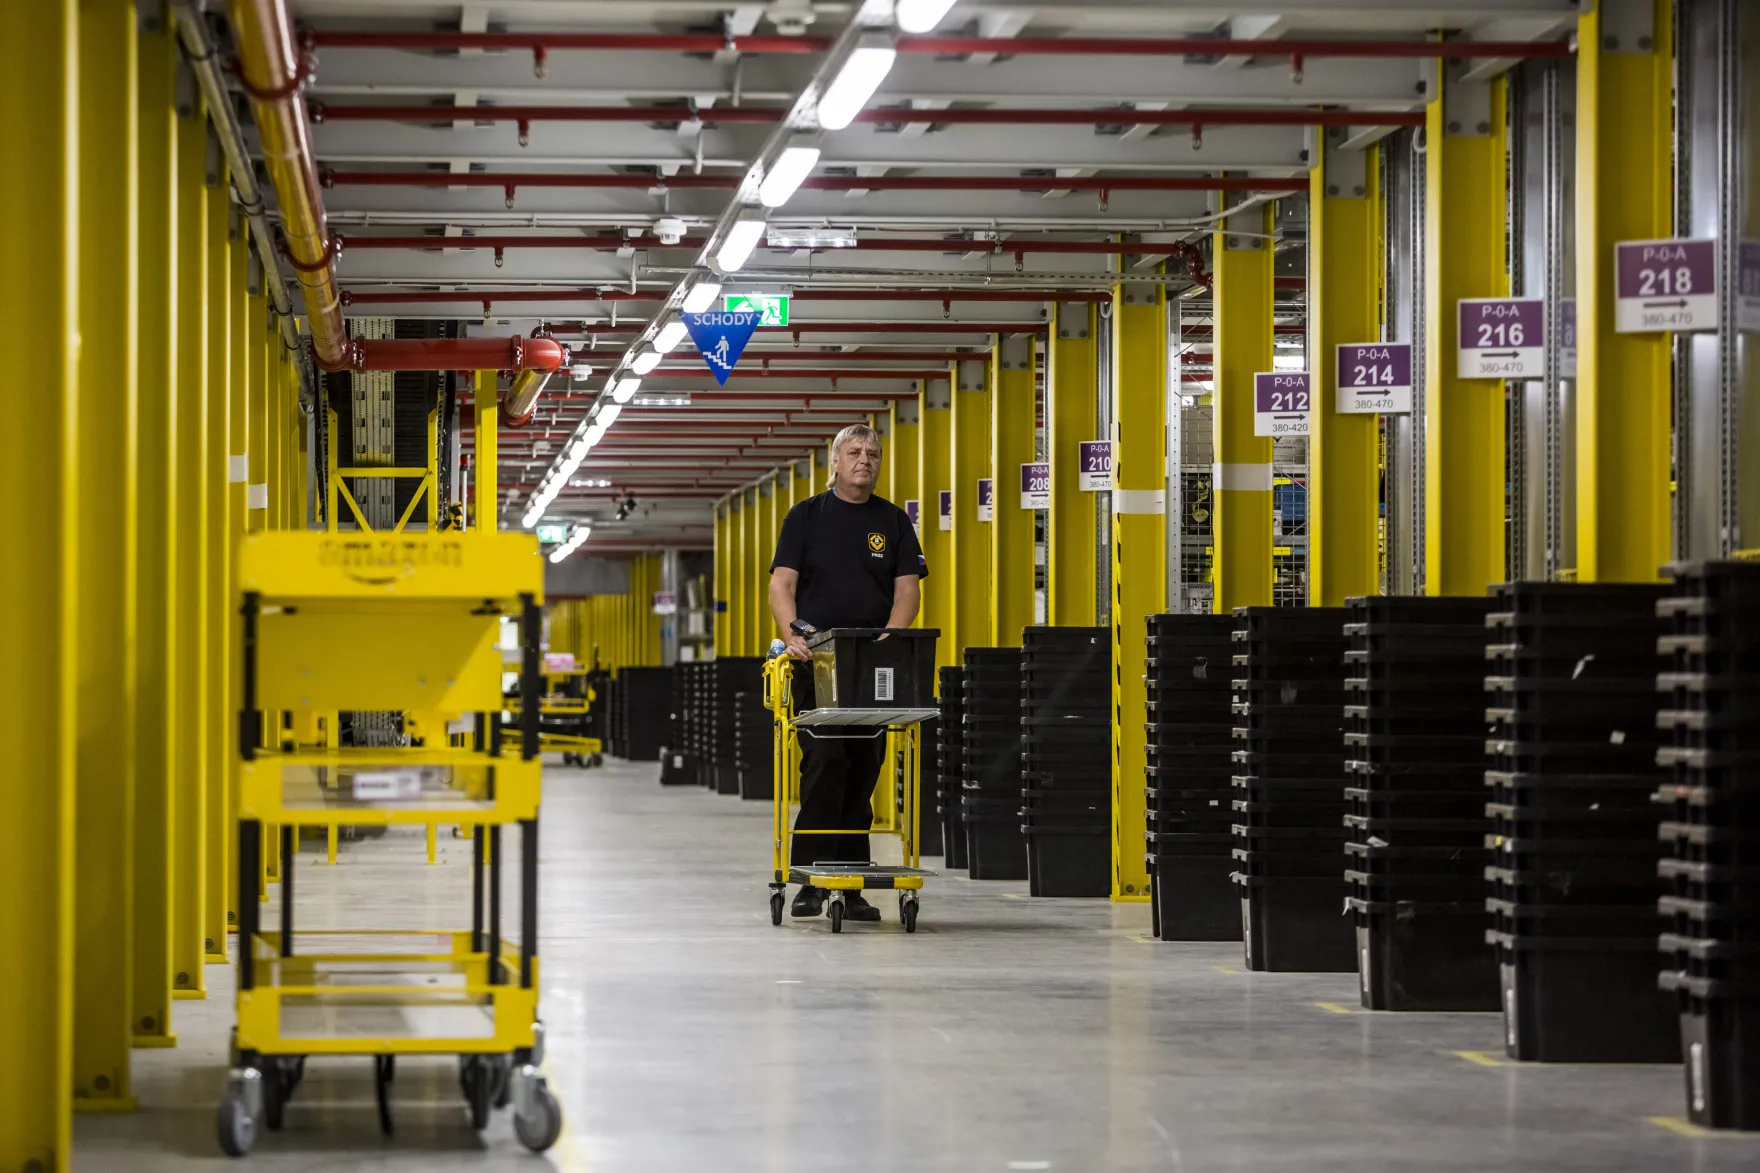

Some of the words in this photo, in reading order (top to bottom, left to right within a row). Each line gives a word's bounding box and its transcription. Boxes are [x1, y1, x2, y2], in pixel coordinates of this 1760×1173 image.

[1642, 245, 1688, 263] P-0-A
[1638, 267, 1693, 296] 218
[1481, 304, 1520, 318] P-0-A
[693, 313, 753, 325] SCHODY
[1641, 311, 1693, 327] 380-470
[1477, 322, 1525, 347] 216
[1357, 348, 1391, 361] P-0-A
[1353, 364, 1395, 386] 214
[1479, 362, 1524, 374] 380-470
[1274, 376, 1305, 388] P-0-A
[1270, 391, 1309, 411] 212
[1354, 399, 1394, 410] 380-470
[1272, 423, 1309, 433] 380-420
[1090, 444, 1109, 452] P-0-A
[1088, 456, 1111, 471] 210
[1029, 477, 1049, 491] 208
